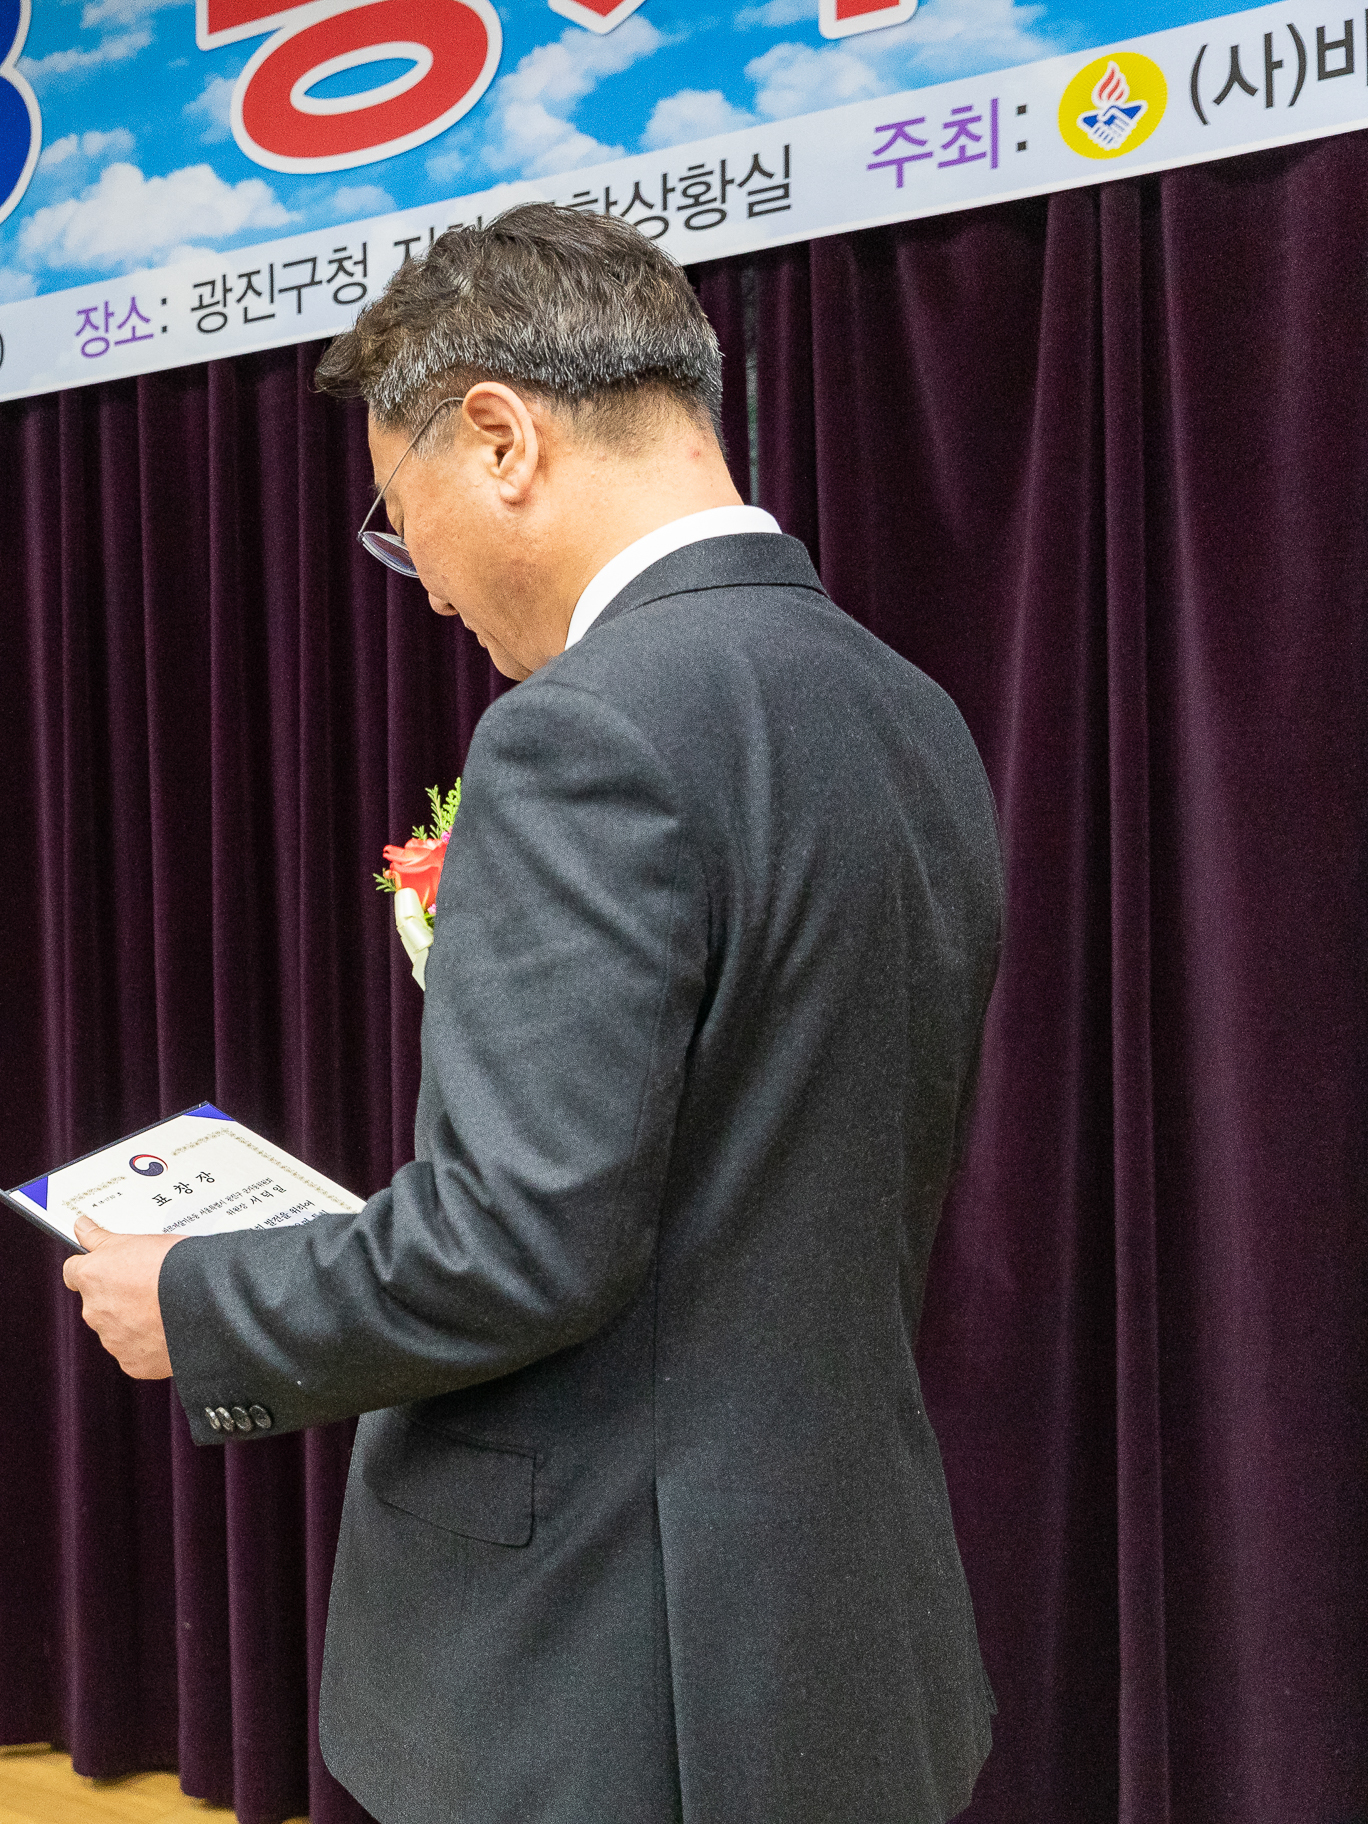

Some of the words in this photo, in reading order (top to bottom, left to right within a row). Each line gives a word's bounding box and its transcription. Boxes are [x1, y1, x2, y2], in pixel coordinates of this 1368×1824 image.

[866, 97, 1028, 189] 주최:
[75, 297, 169, 360] 장소:
[189, 242, 370, 337] 광진구청
